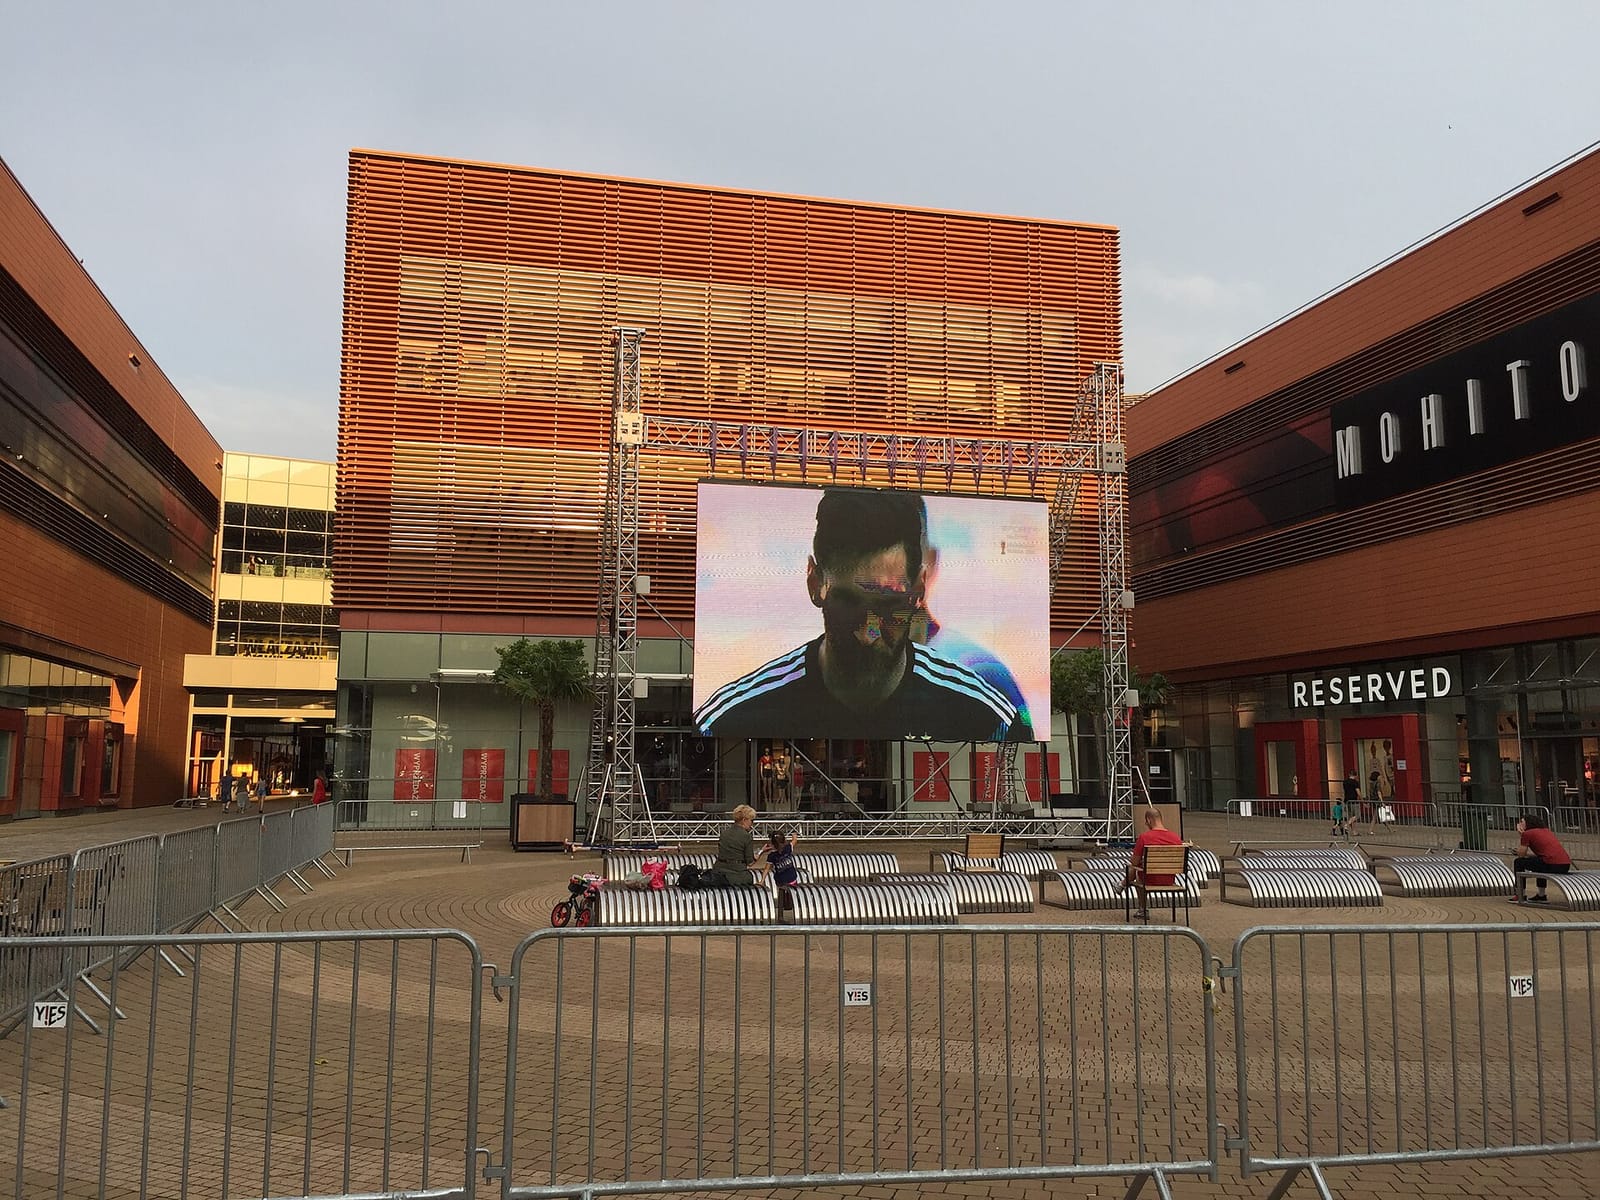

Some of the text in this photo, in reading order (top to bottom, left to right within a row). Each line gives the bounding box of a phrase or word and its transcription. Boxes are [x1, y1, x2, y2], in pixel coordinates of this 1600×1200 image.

[1336, 340, 1584, 480] MOHITO
[1294, 667, 1451, 707] RESERVED
[479, 752, 488, 800] WYPRZEDAŻ
[928, 754, 936, 799] WYPREDAŻ
